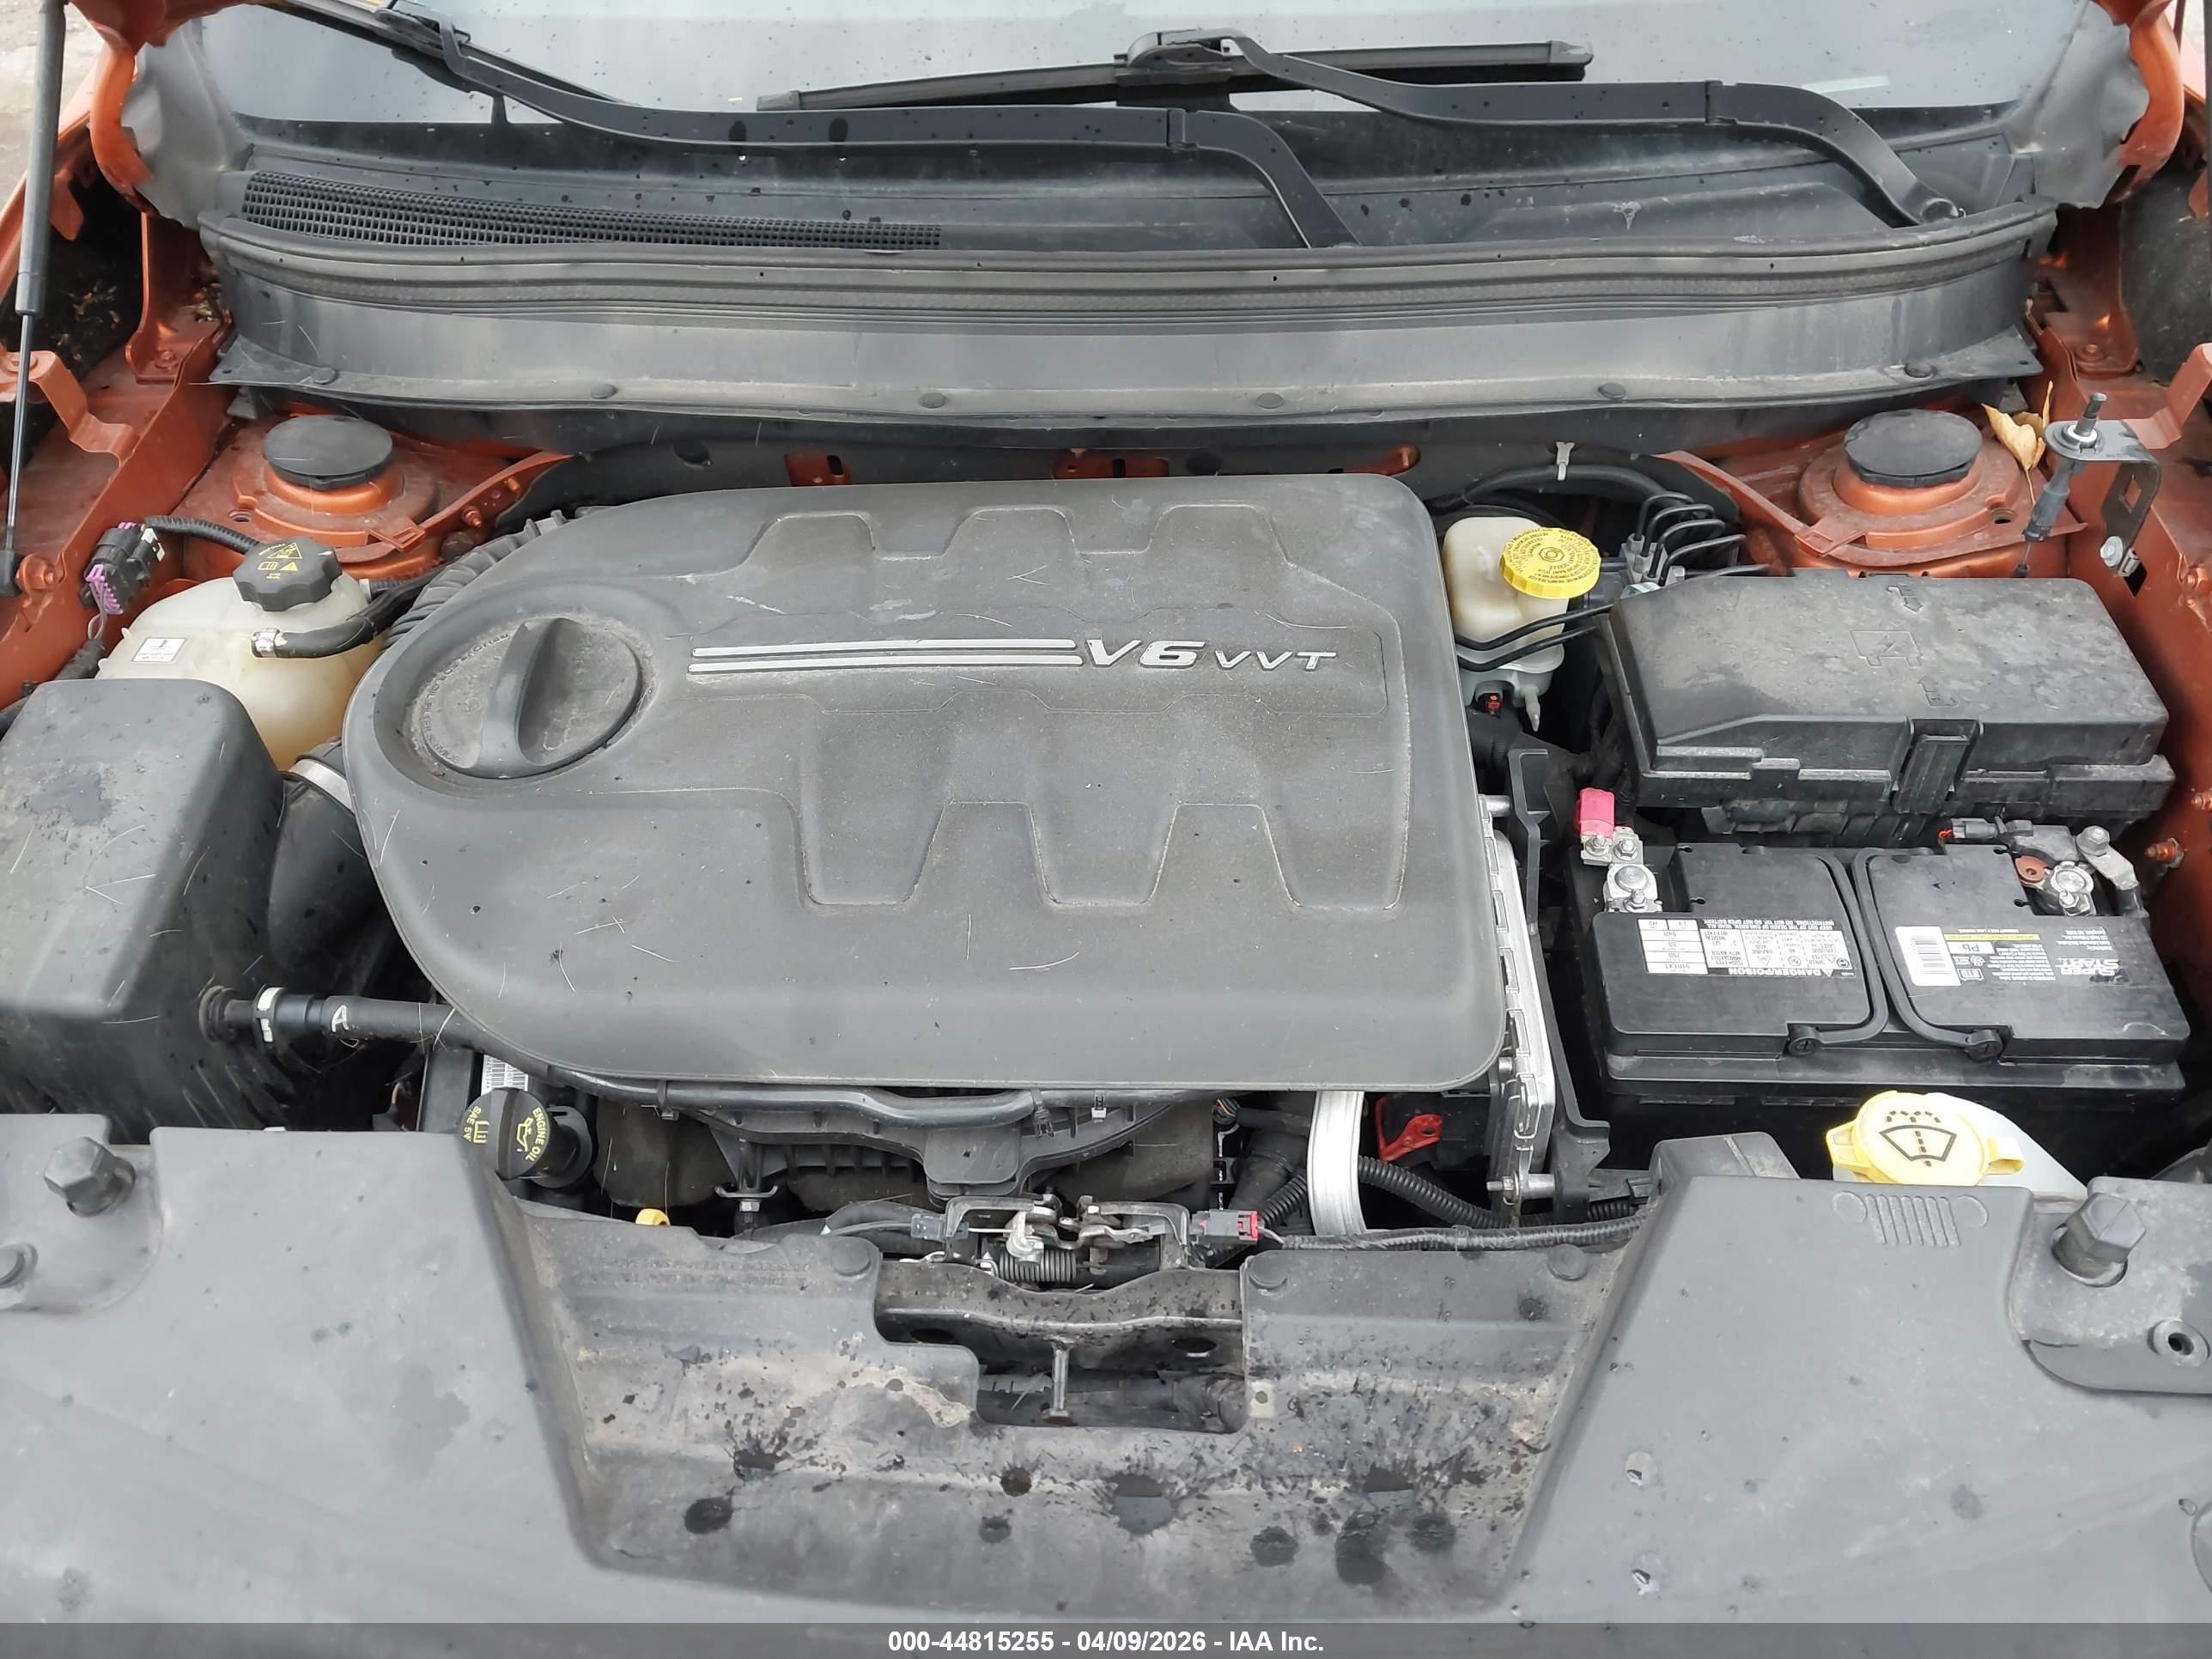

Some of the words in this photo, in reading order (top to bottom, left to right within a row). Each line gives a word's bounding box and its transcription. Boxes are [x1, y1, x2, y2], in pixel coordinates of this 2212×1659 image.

[459, 632, 509, 662] REMOVE
[1085, 640, 1204, 669] V6
[1213, 650, 1336, 672] VVT
[439, 662, 459, 682] FOR
[428, 682, 441, 701] OIL
[1962, 943, 1979, 952] Pb
[1729, 968, 1821, 976] DANGER/POISON
[2055, 958, 2119, 969] START
[2060, 967, 2116, 975] SUPER
[331, 1003, 349, 1032] A
[466, 1105, 482, 1125] SAE
[532, 1107, 547, 1146] ENGINE
[526, 1146, 541, 1162] OIL
